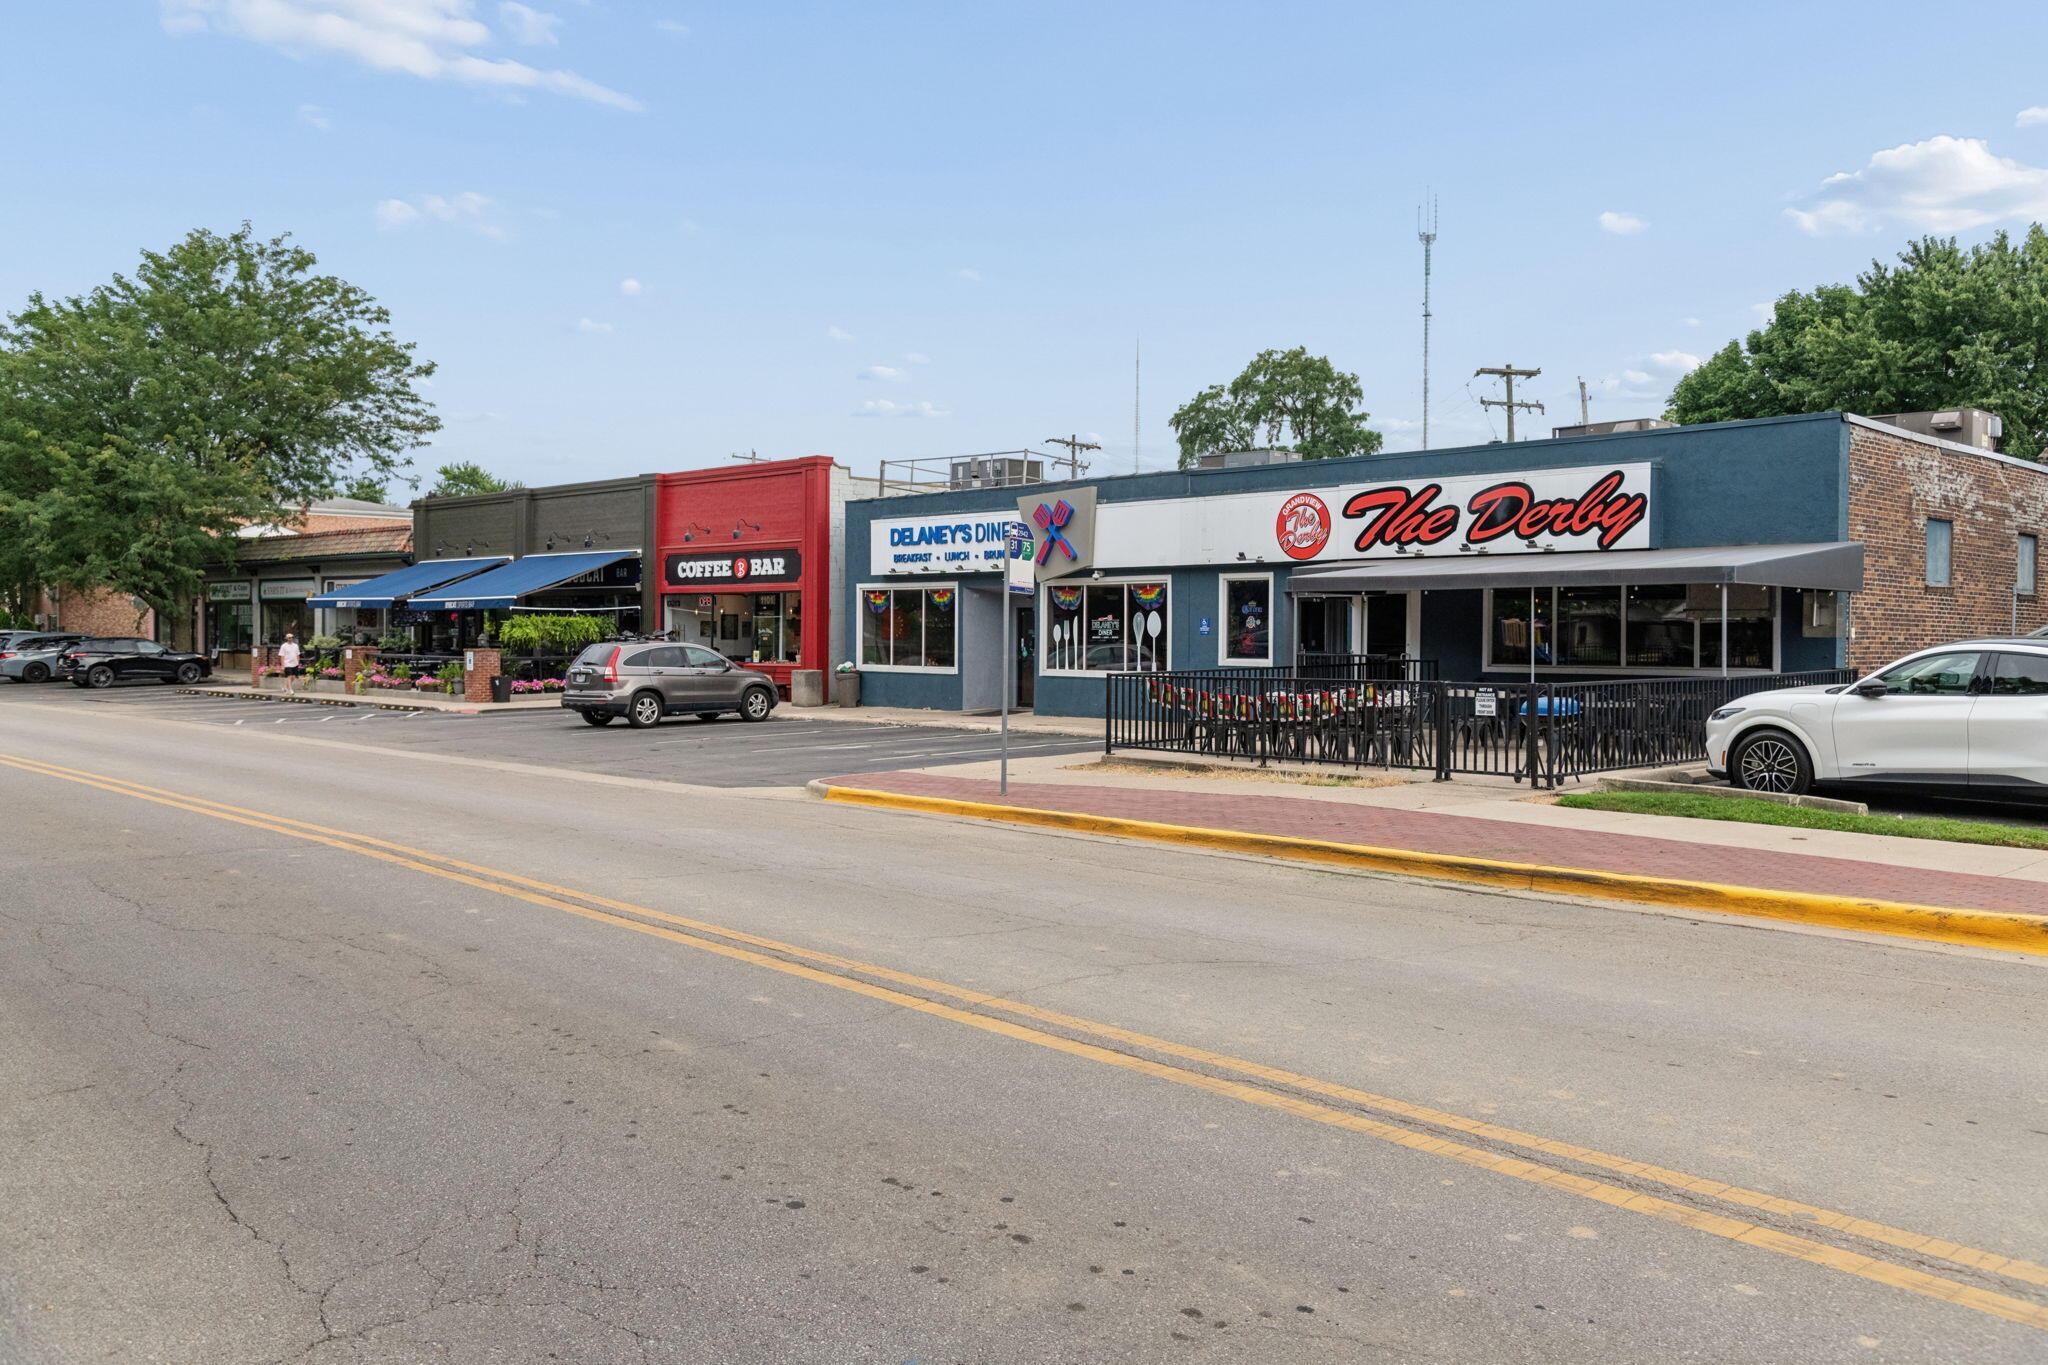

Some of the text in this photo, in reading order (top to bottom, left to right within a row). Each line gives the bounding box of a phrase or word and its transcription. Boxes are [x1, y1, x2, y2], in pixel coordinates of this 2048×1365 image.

[1282, 496, 1322, 516] GRANDVIEW
[1342, 469, 1648, 552] The Derby
[1286, 507, 1316, 533] The
[890, 521, 1010, 547] DELANEY'S DINE
[1010, 540, 1018, 550] 31
[1279, 519, 1329, 552] Derby
[893, 550, 1006, 563] BREAKFAST LUNCH BRUN
[1022, 541, 1031, 552] 75
[677, 560, 732, 579] COFFEE
[750, 557, 786, 576] BAR
